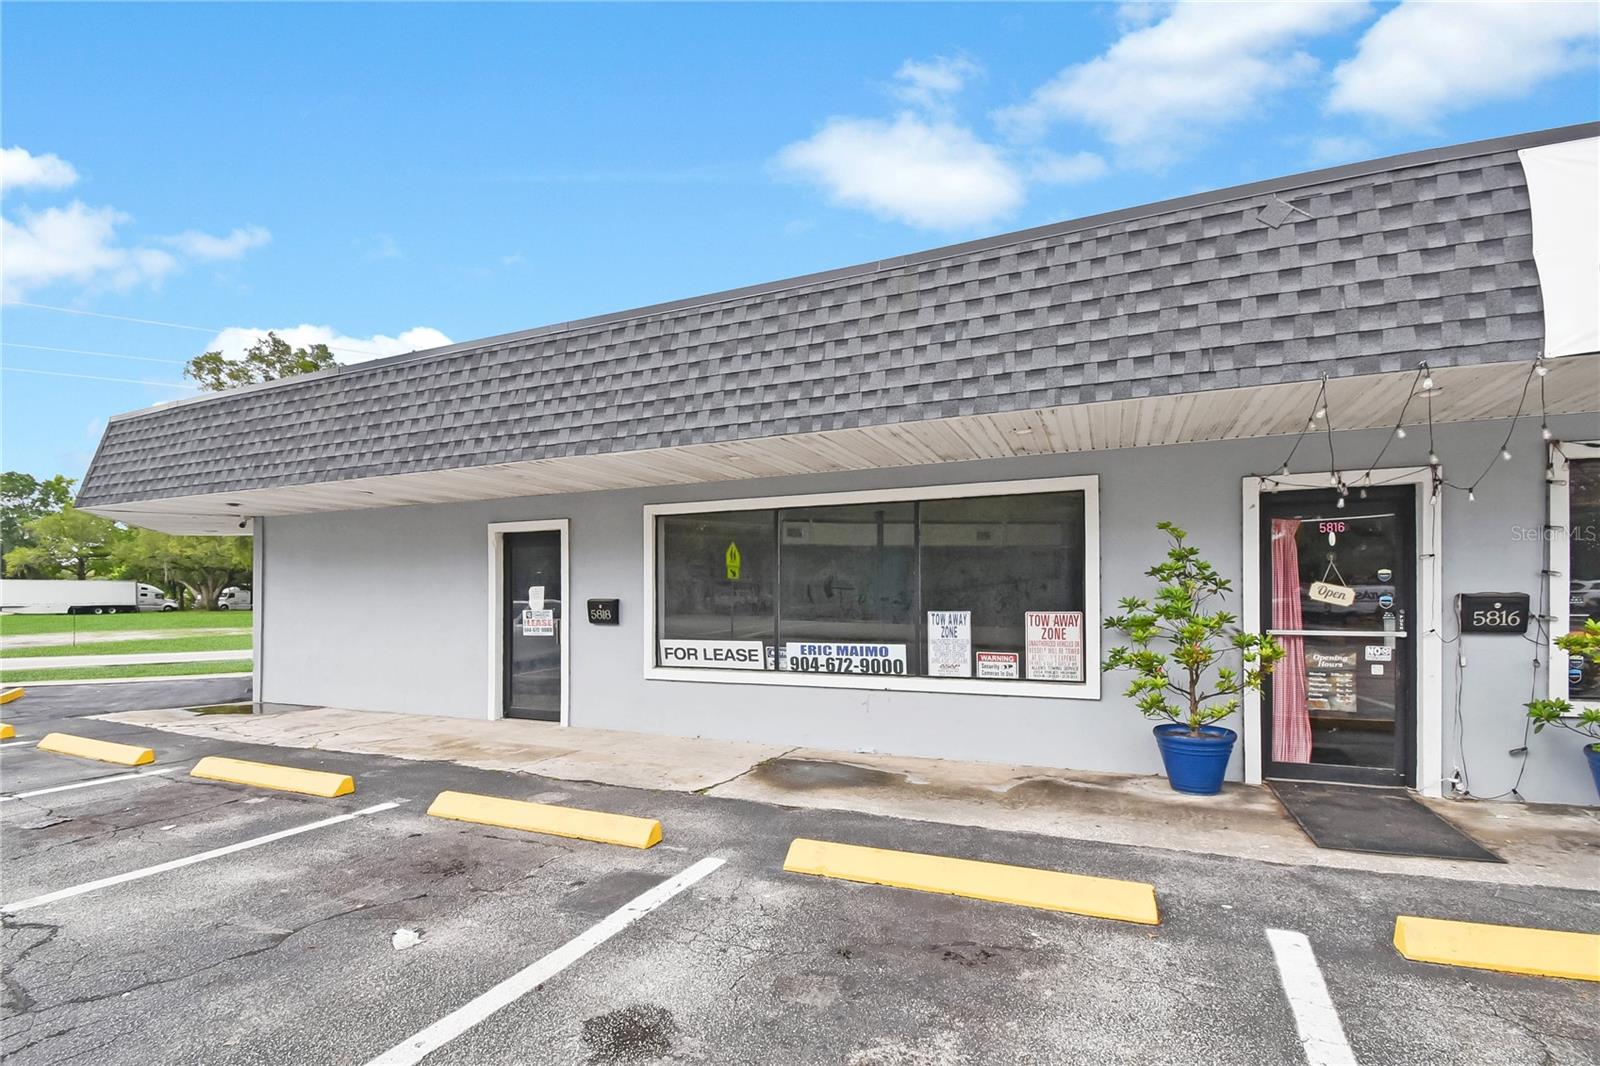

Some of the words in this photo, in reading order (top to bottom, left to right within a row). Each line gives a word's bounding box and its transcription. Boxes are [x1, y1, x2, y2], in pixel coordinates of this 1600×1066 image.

[1319, 522, 1345, 533] 5816
[1317, 585, 1347, 600] Open
[590, 609, 611, 620] 5818
[931, 613, 946, 626] TOW
[948, 613, 968, 626] AWAY
[1029, 614, 1050, 627] TOW
[1054, 614, 1079, 627] AWAY
[1473, 610, 1520, 626] 5816
[941, 626, 958, 638] ZONE
[1041, 627, 1067, 640] ZONE
[664, 647, 698, 660] FOR
[703, 648, 759, 662] LEASE
[800, 644, 832, 656] ERIC
[836, 645, 889, 657] MAIMO
[1312, 654, 1349, 662] Opening
[1317, 660, 1343, 668] Hours
[790, 656, 904, 674] 904-672-9000
